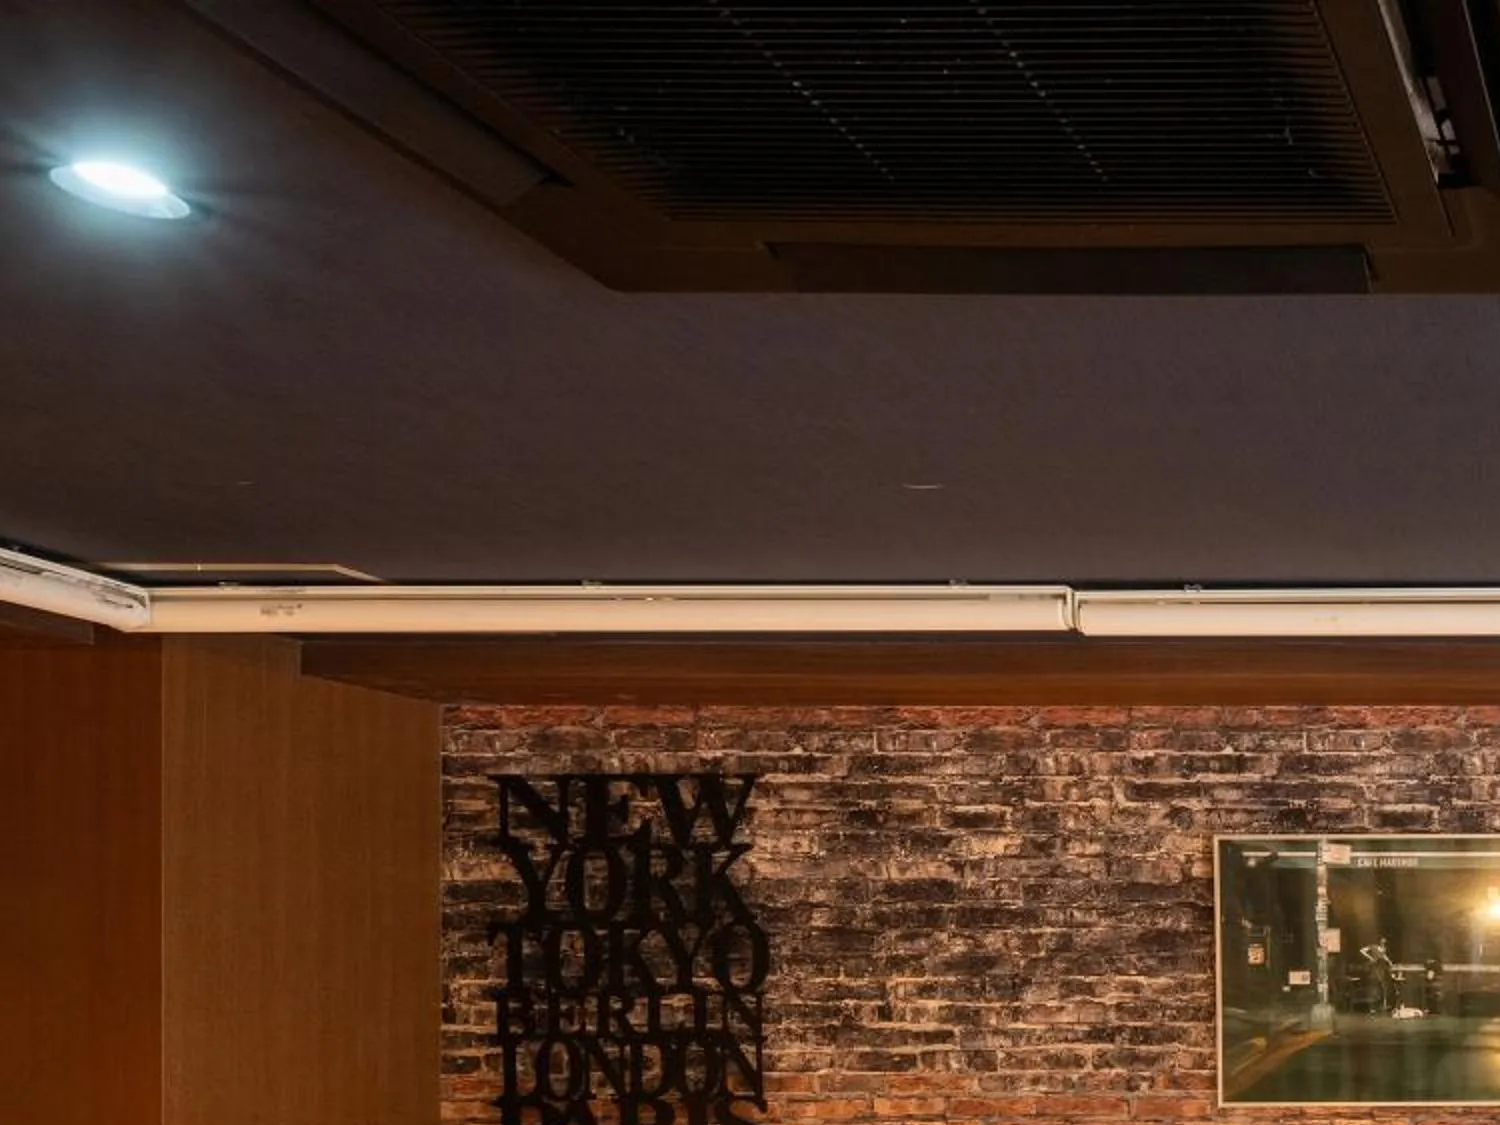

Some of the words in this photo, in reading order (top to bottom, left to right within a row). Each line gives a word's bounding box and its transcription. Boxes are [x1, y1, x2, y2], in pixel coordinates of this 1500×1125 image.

[488, 773, 757, 848] NEW
[500, 838, 758, 926] YORK
[488, 920, 771, 992] TOKYO
[491, 990, 764, 1040] BERLIN
[493, 1034, 766, 1098] LONDON
